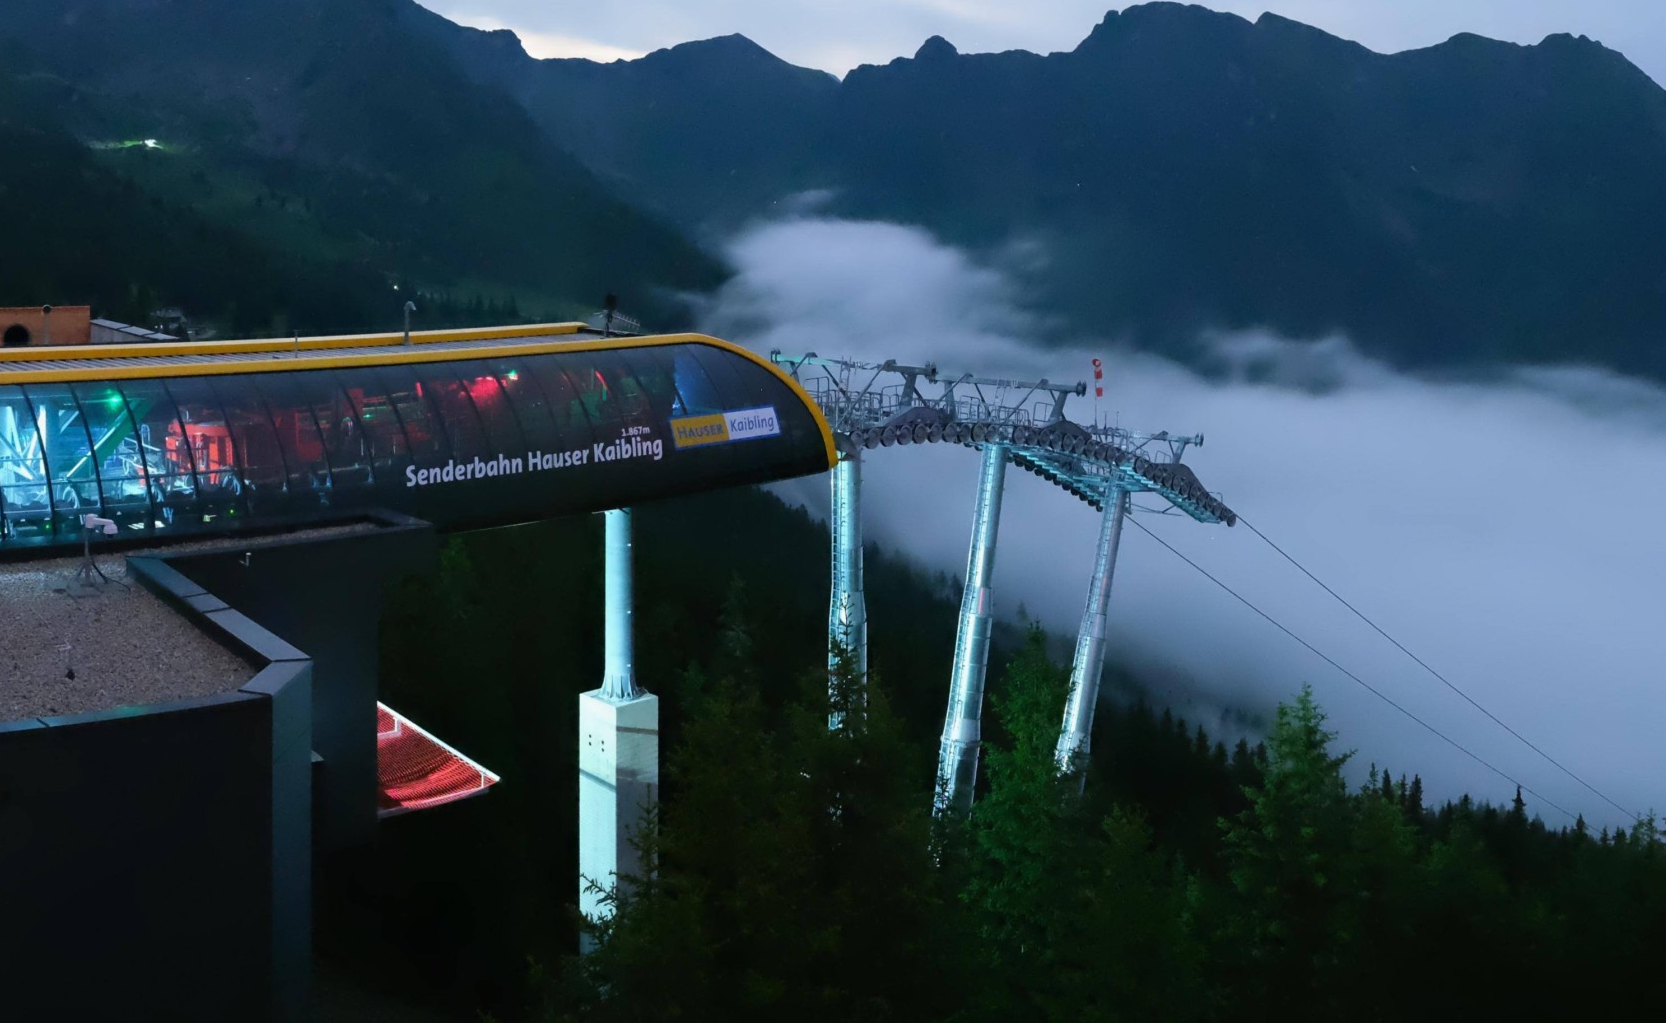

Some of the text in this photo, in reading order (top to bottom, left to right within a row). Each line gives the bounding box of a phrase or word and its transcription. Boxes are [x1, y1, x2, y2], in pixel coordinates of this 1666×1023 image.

[621, 425, 651, 437] 1.867m
[677, 414, 775, 440] HAUSER Kaibling
[405, 437, 664, 488] Senderbahn Hauser Kaibling
